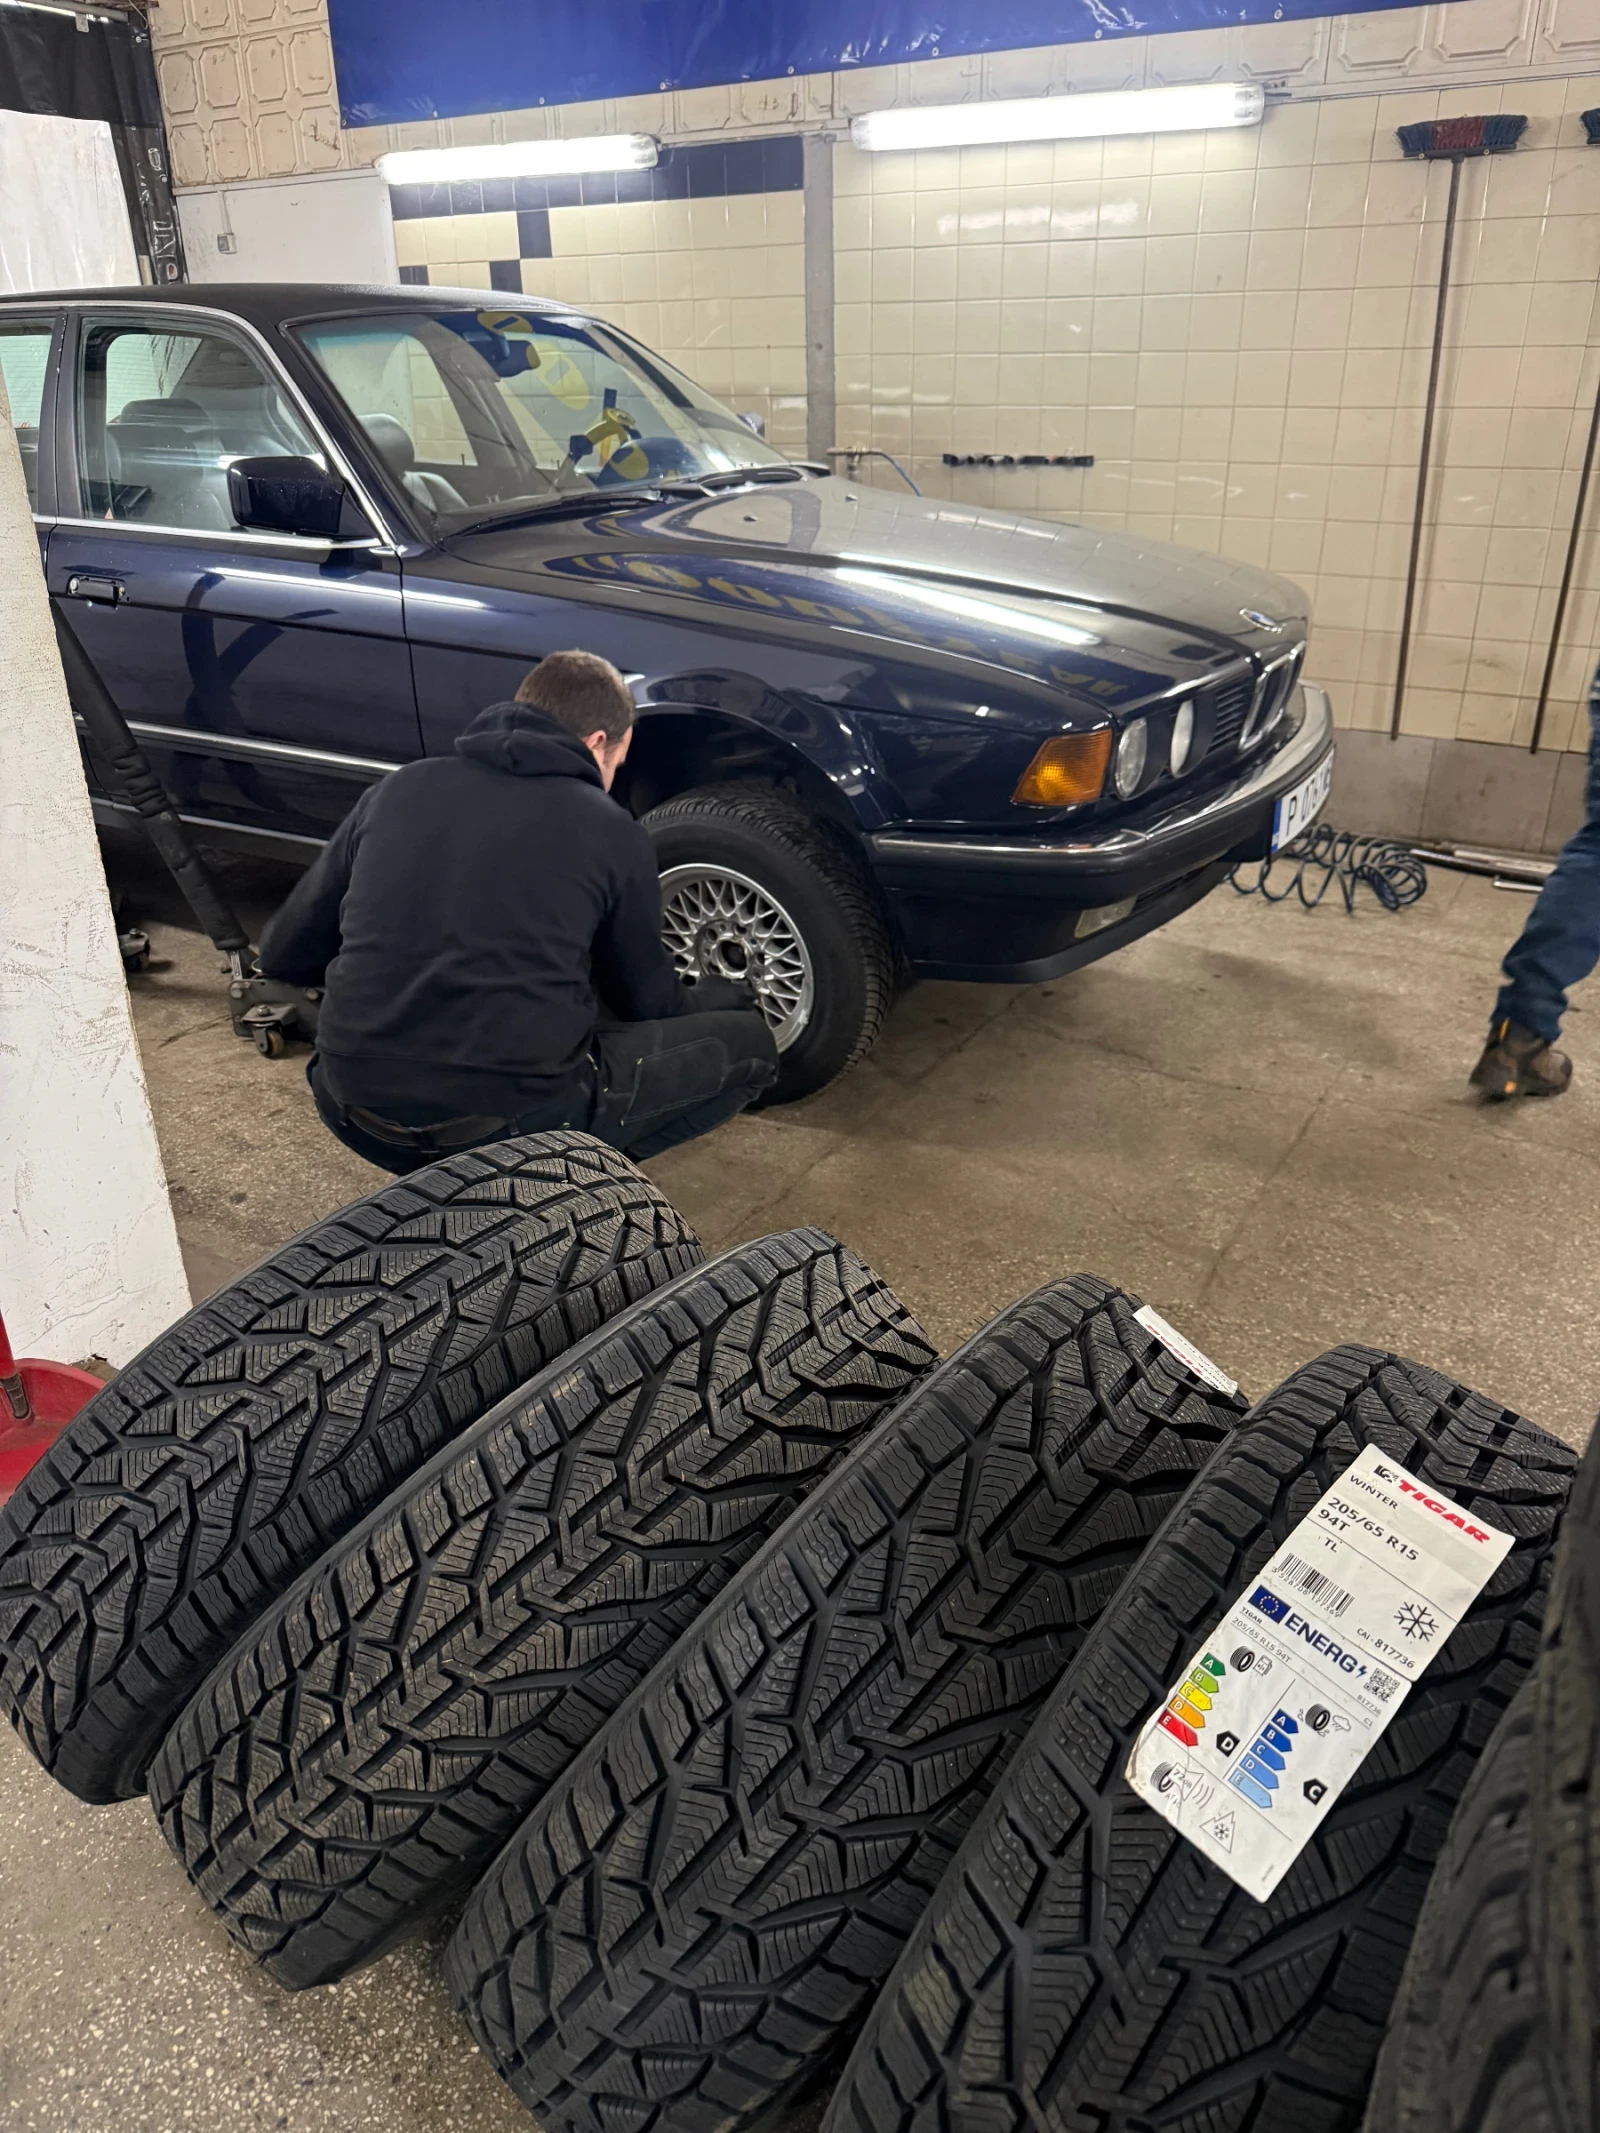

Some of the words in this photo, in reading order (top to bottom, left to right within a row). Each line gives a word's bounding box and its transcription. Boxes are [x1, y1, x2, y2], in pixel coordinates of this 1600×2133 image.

[1350, 1474, 1398, 1510] WINTER
[1398, 1479, 1491, 1544] TIGAR
[1317, 1508, 1351, 1532] 94T
[1327, 1497, 1385, 1538] 205/65
[1385, 1535, 1419, 1561] R15
[1324, 1536, 1337, 1553] TL
[1241, 1606, 1263, 1625] TIGAR
[1231, 1616, 1261, 1639] 205/65
[1259, 1636, 1277, 1652] R15
[1275, 1648, 1293, 1663] 94T
[1356, 1627, 1370, 1640] CAI
[1374, 1638, 1416, 1669] 817736
[1204, 1659, 1214, 1669] A
[1194, 1672, 1204, 1682] B
[1183, 1686, 1194, 1697] C
[1173, 1699, 1184, 1712] D
[1162, 1714, 1172, 1726] E
[1276, 1715, 1286, 1726] A
[1266, 1729, 1276, 1740] B
[1220, 1736, 1235, 1751] D
[1256, 1744, 1266, 1755] C
[1245, 1759, 1255, 1770] D
[1233, 1773, 1244, 1785] E
[1308, 1785, 1322, 1799] C
